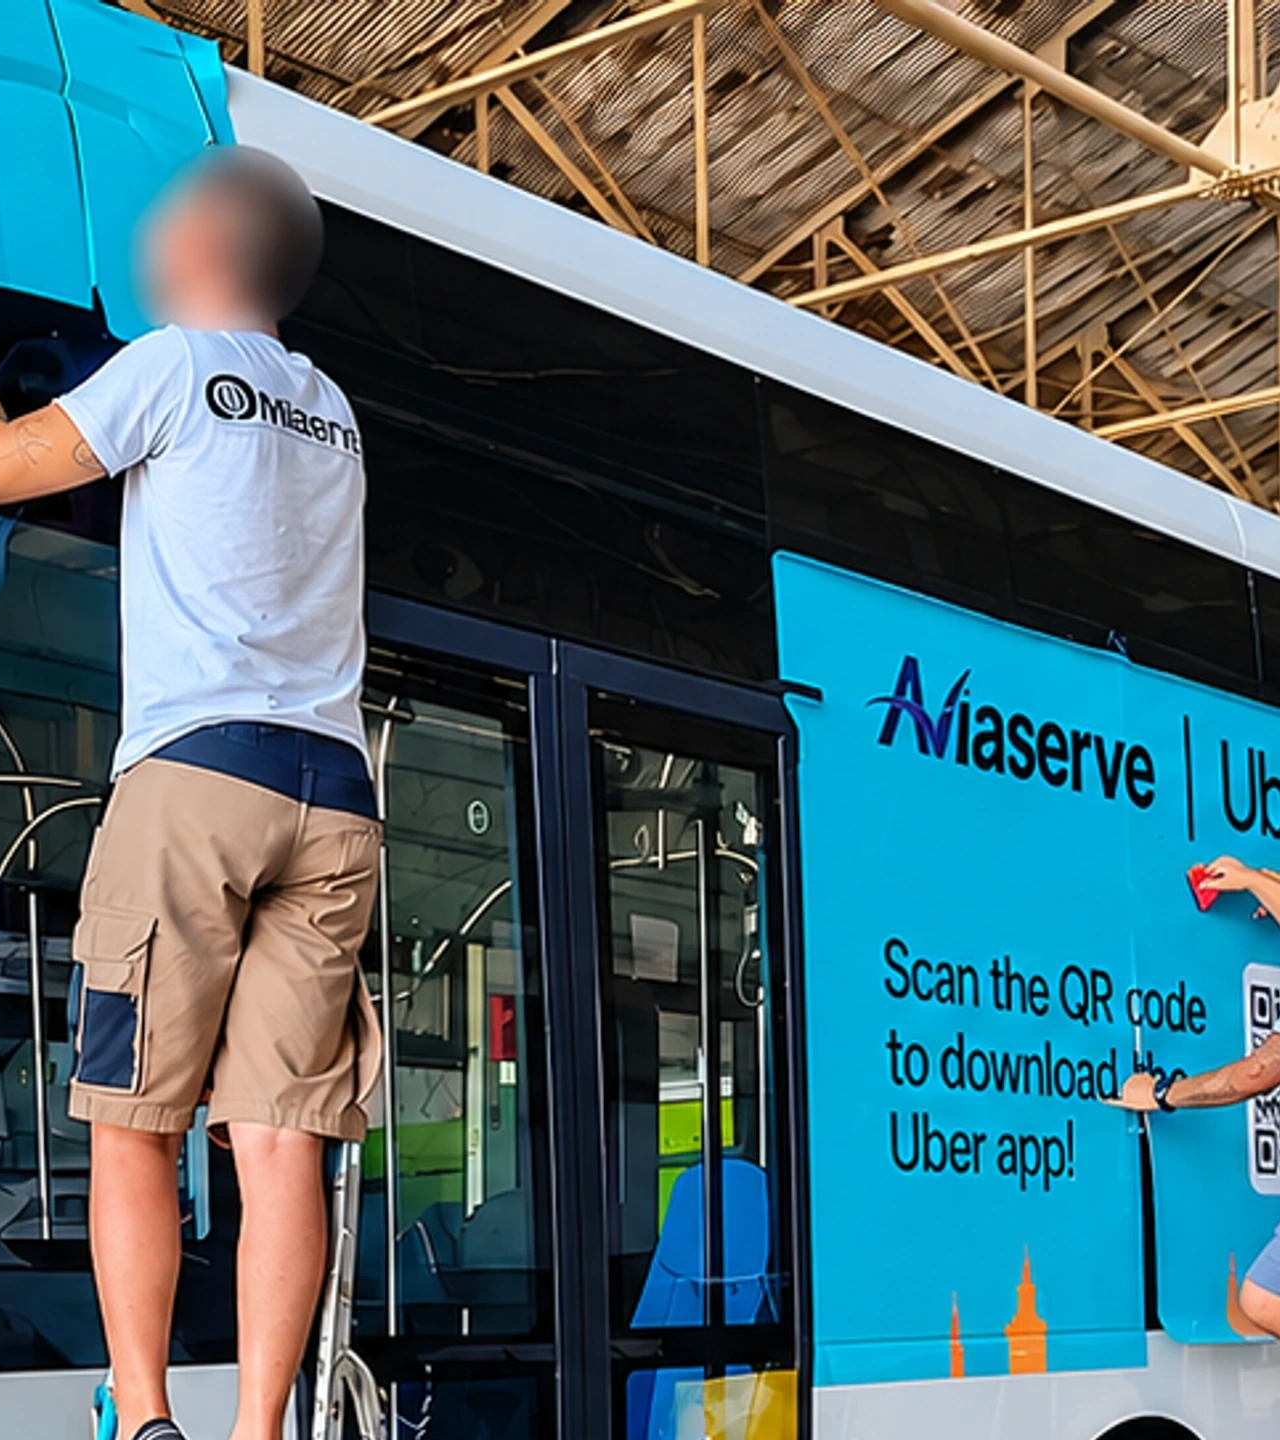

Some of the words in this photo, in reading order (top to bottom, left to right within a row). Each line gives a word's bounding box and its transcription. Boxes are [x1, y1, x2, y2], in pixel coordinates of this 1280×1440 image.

[883, 938, 979, 1008] Scan
[989, 955, 1049, 1017] the
[1060, 964, 1114, 1027] QR
[1126, 980, 1207, 1035] code
[886, 1029, 929, 1087] to
[941, 1032, 1118, 1100] download
[890, 1111, 987, 1174] Uber
[997, 1119, 1074, 1192] app!
